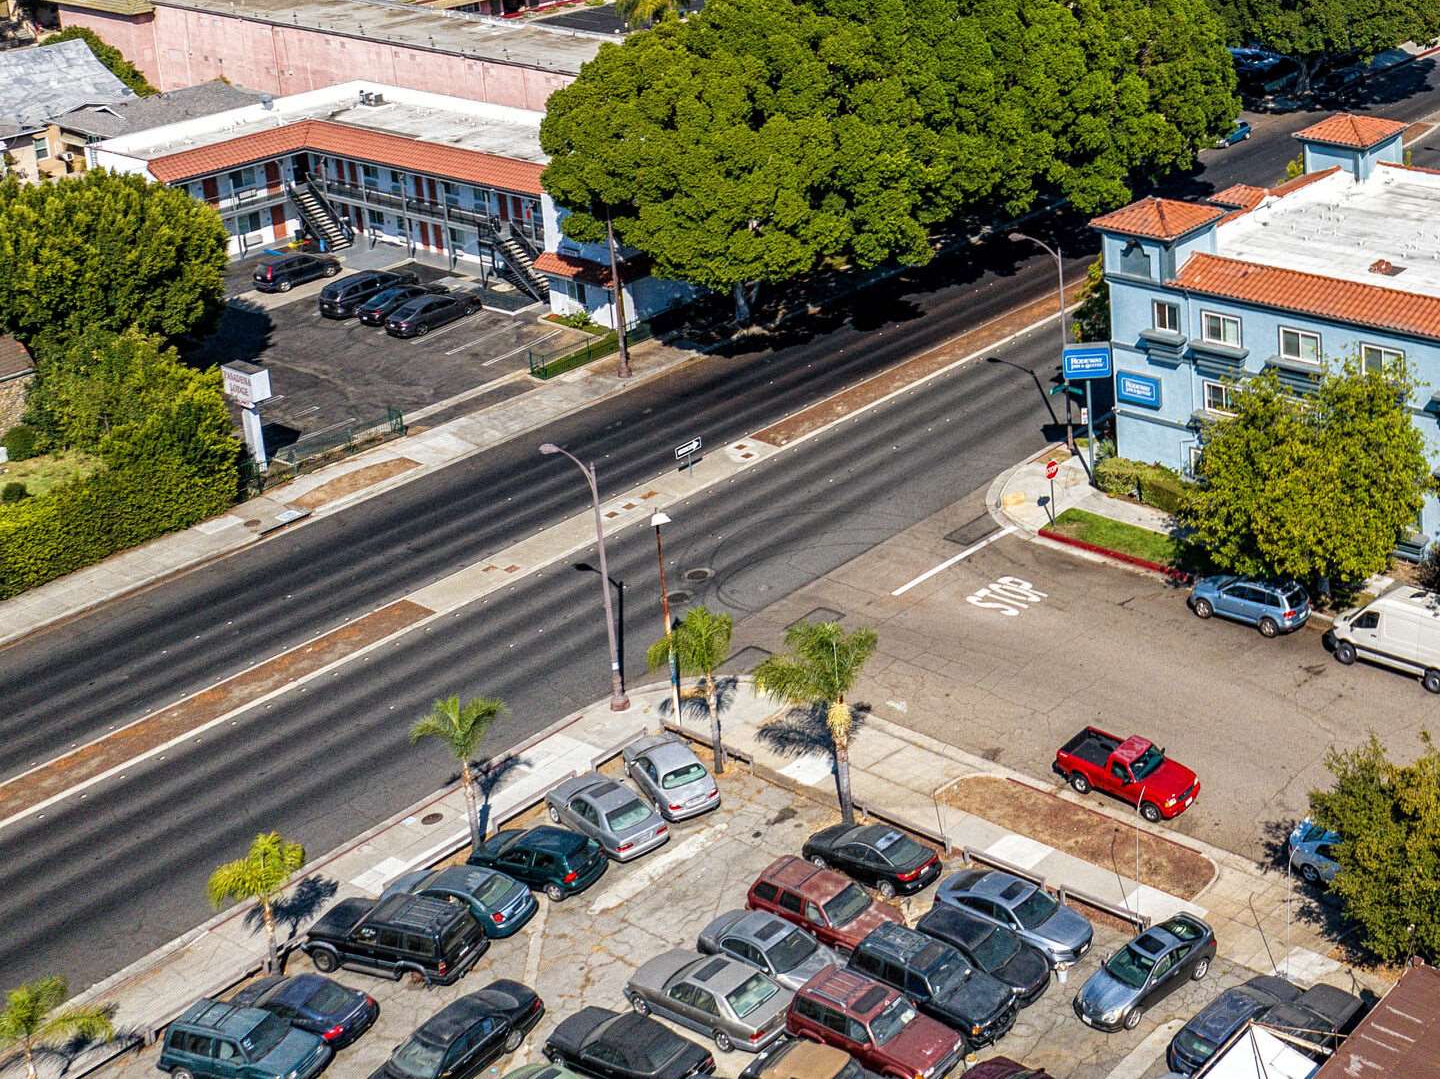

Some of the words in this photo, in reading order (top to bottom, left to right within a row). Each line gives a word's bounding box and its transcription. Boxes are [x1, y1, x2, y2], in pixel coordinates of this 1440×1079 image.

[223, 371, 252, 386] PASADENA
[230, 383, 249, 396] LODGE
[966, 576, 1048, 616] STOP
